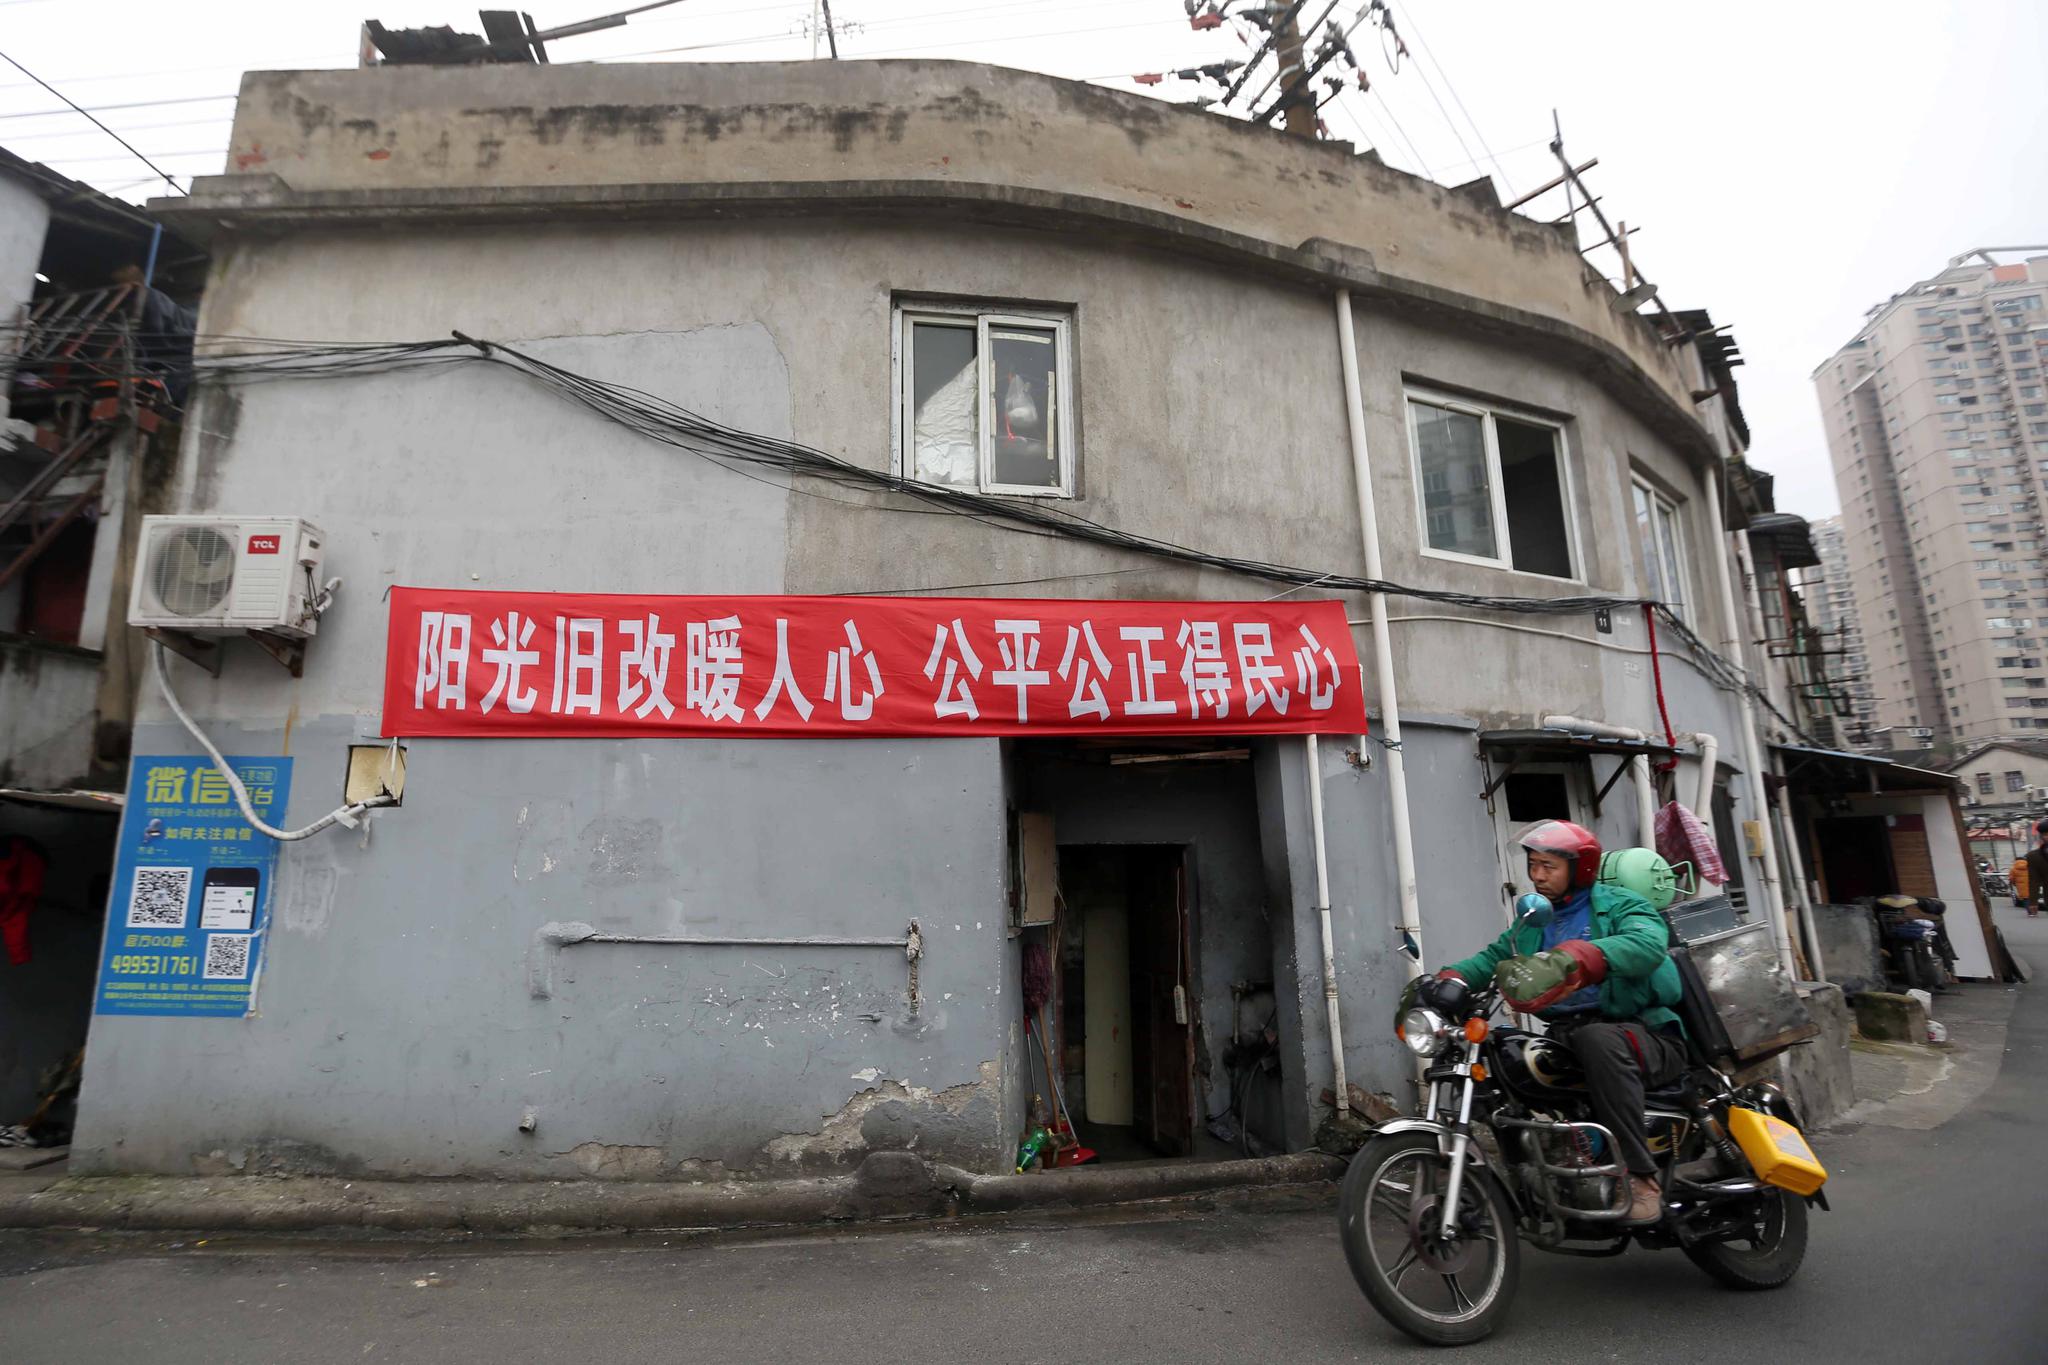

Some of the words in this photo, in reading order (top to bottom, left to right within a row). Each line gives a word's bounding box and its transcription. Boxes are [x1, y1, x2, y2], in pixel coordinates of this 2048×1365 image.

[252, 540, 276, 549] TCL
[414, 611, 885, 723] 阳光旧改暖人心
[923, 617, 1342, 724] 公平公正得民心
[111, 955, 199, 975] 499531761
